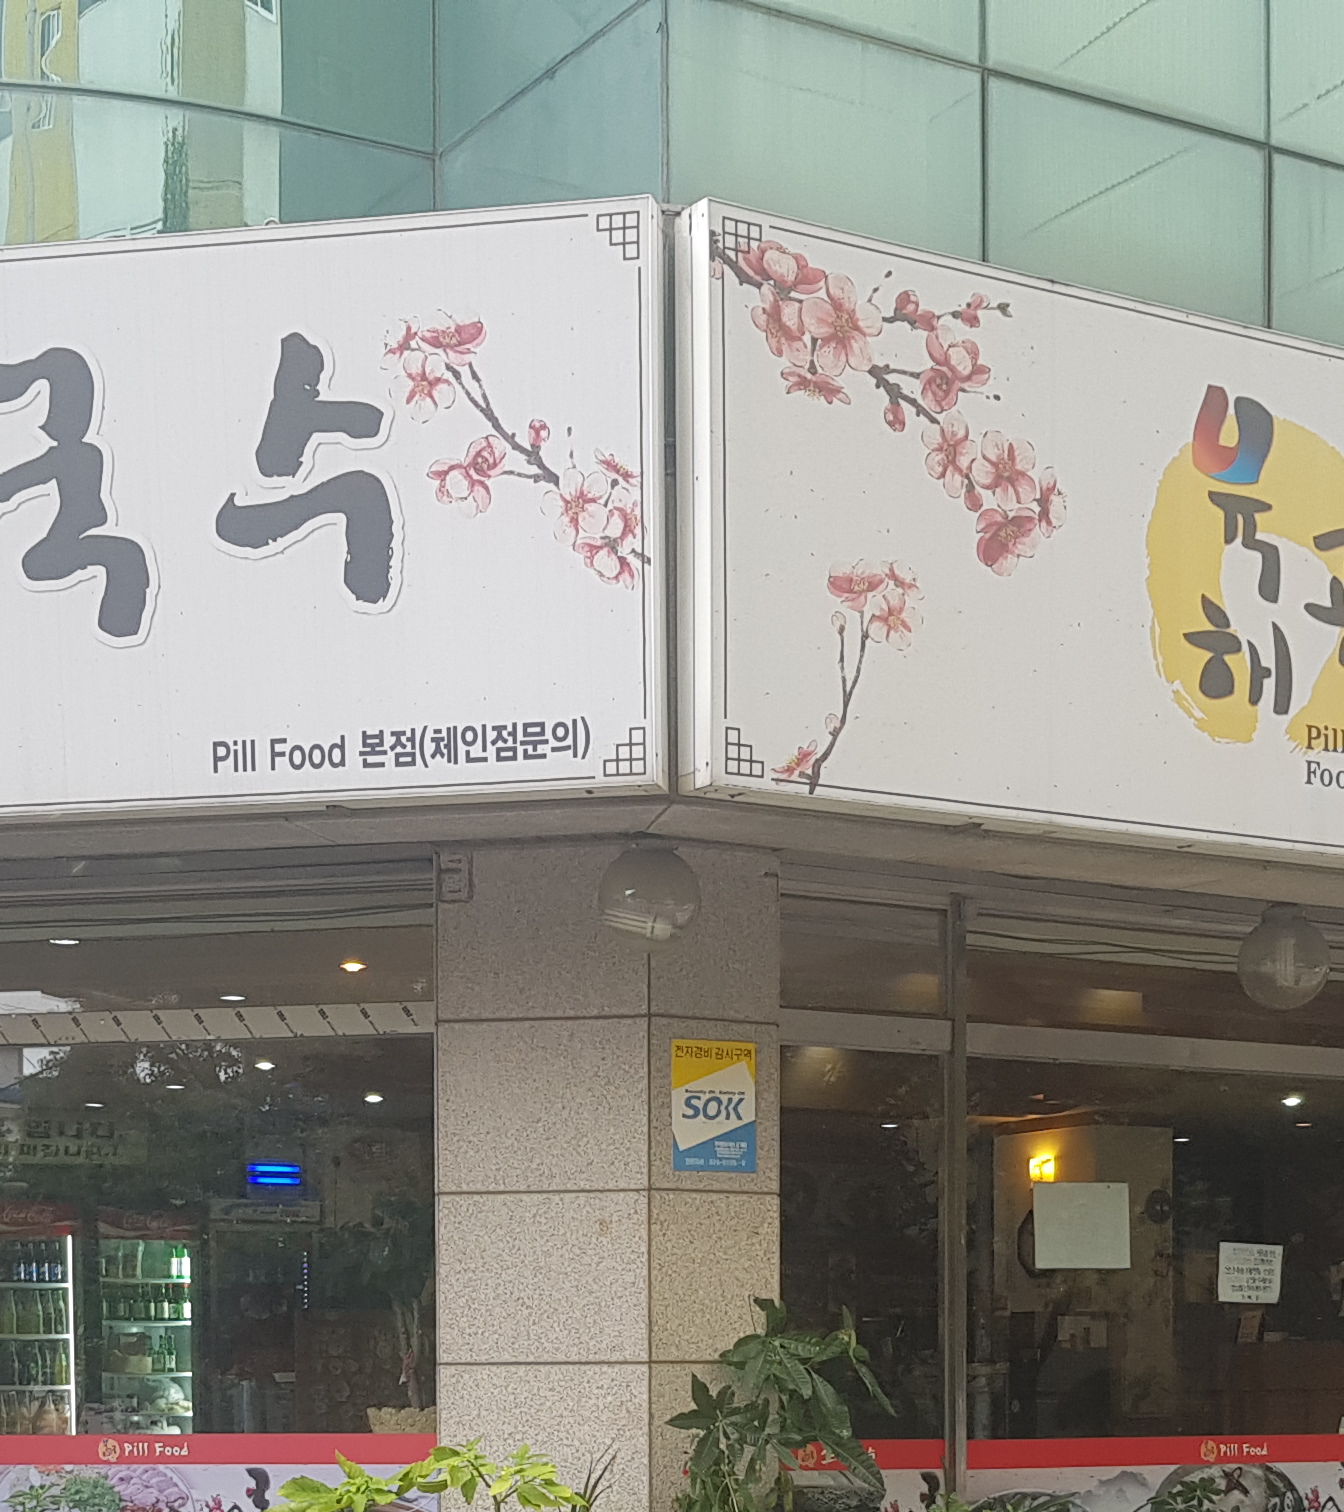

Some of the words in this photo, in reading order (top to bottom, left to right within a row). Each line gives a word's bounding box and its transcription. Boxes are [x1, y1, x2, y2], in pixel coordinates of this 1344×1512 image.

[211, 739, 257, 775] Pill
[268, 735, 346, 773] Food
[714, 1047, 753, 1062] 감시구역
[681, 1094, 746, 1121] SOK
[123, 1442, 149, 1457] Pill
[154, 1441, 189, 1456] Food
[1219, 1443, 1238, 1457] Pill
[1242, 1442, 1268, 1456] Food
